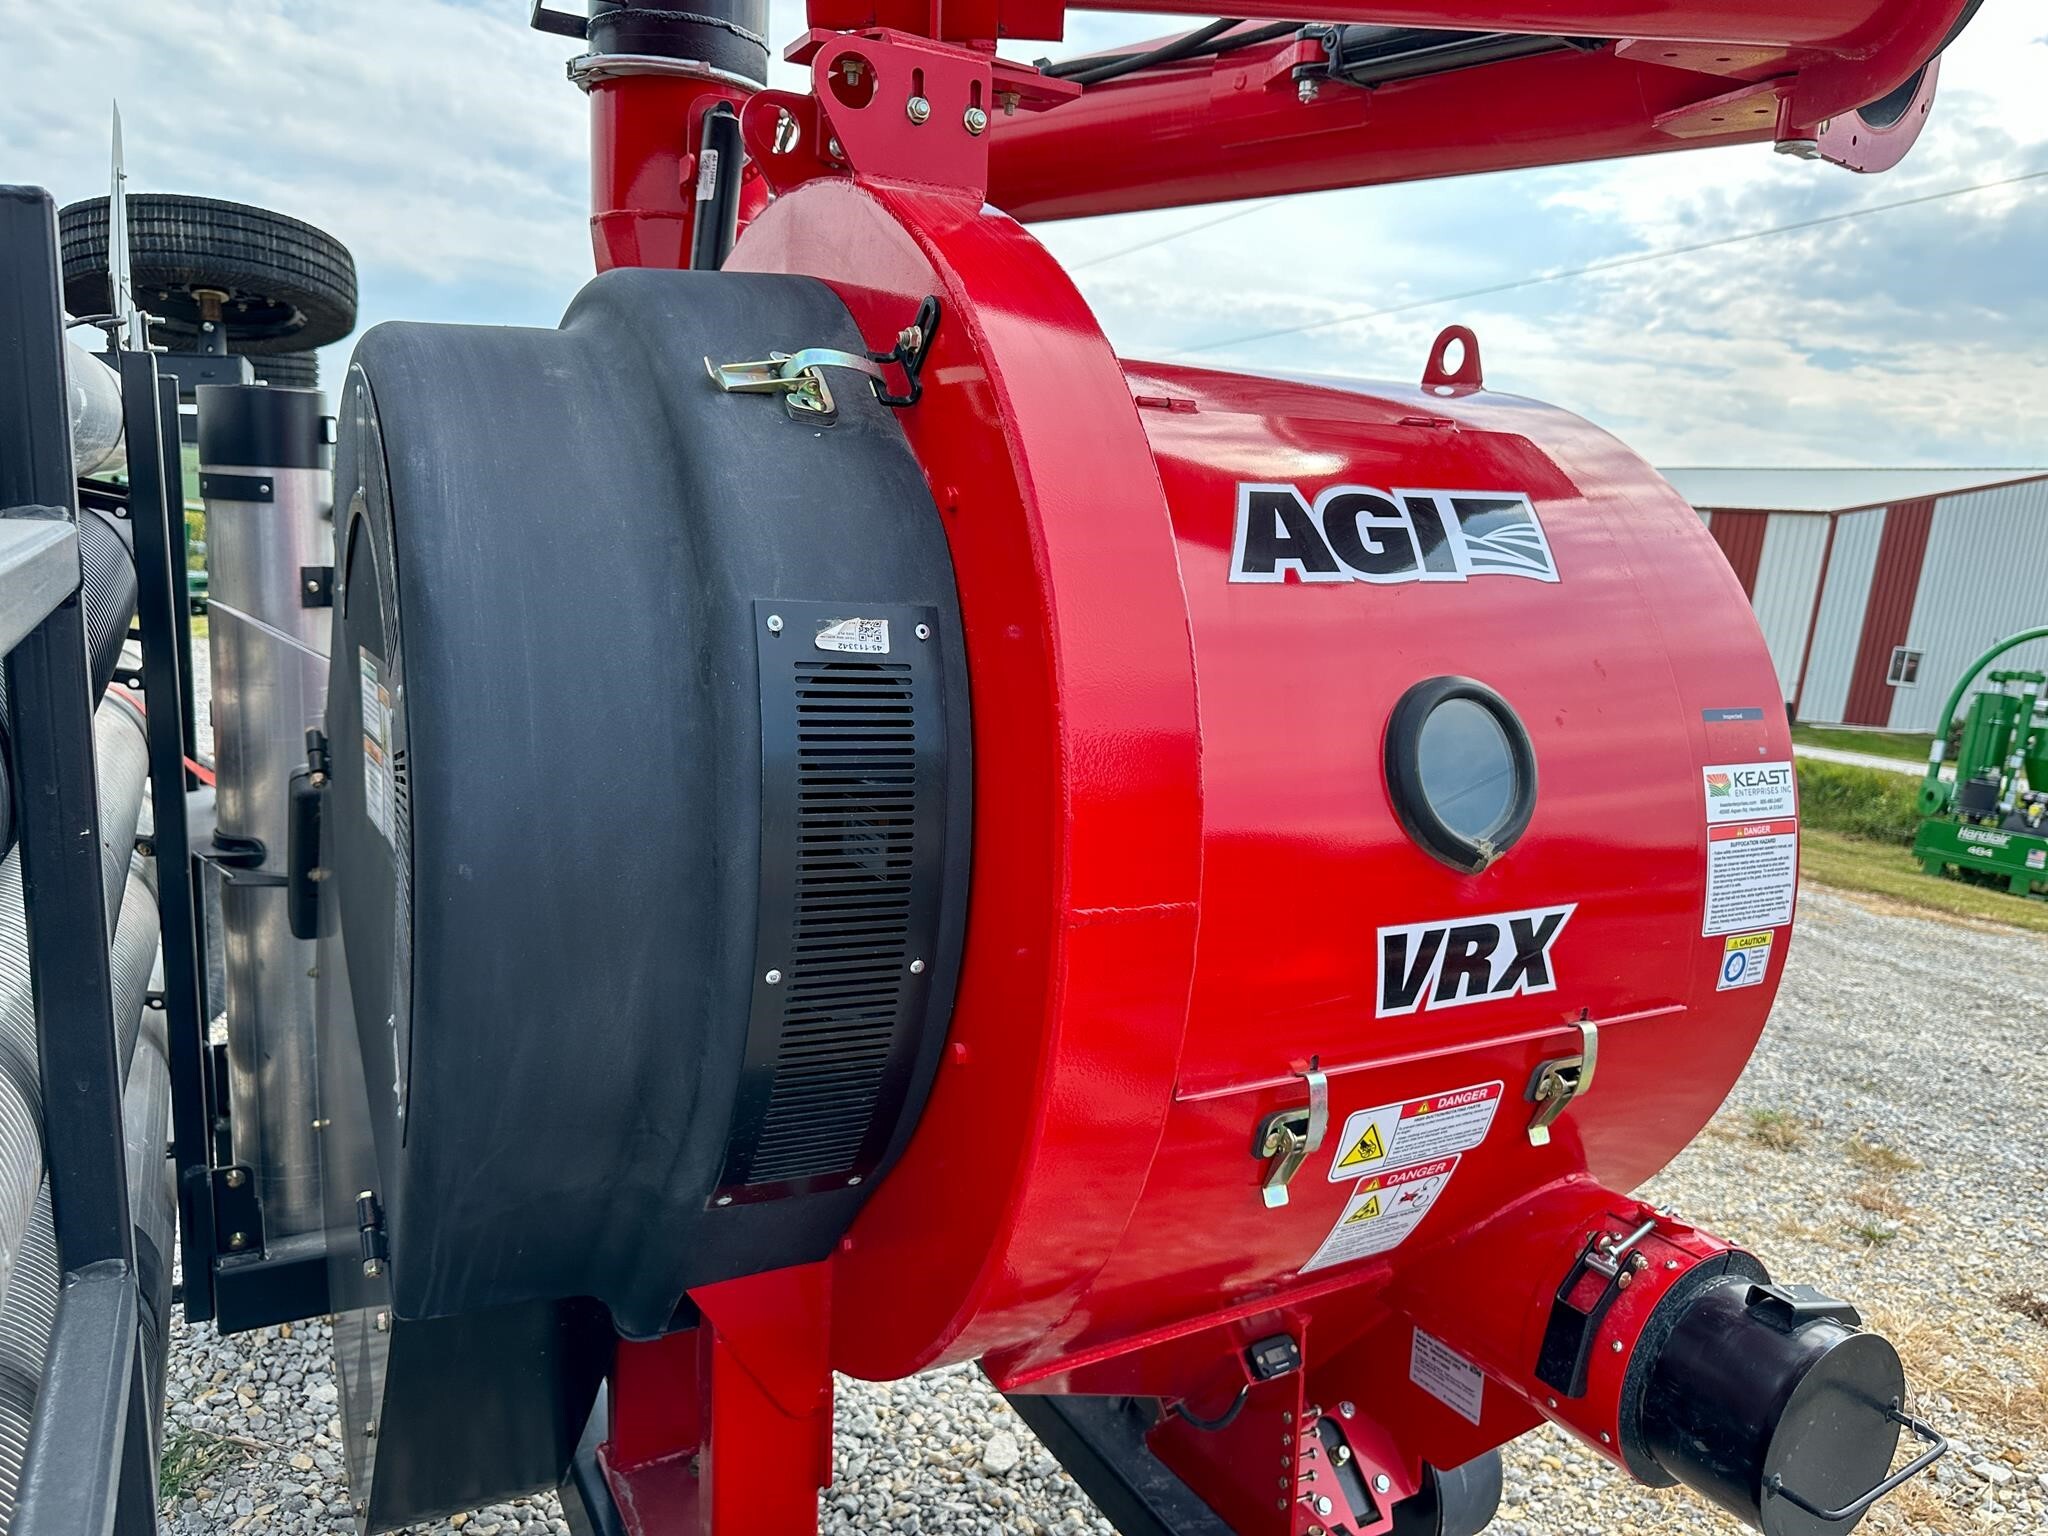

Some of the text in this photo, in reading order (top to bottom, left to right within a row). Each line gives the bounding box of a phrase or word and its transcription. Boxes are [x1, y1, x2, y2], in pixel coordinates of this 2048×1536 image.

[1240, 490, 1459, 576] AGI
[1733, 769, 1790, 788] KEAST
[1734, 785, 1792, 798] ENTERPRISES INC
[1743, 825, 1772, 836] DANGER
[1739, 936, 1767, 946] CAUTION
[1382, 912, 1566, 1010] VRX
[1437, 1088, 1489, 1109] DANGER
[1386, 1162, 1447, 1185] DANGER
